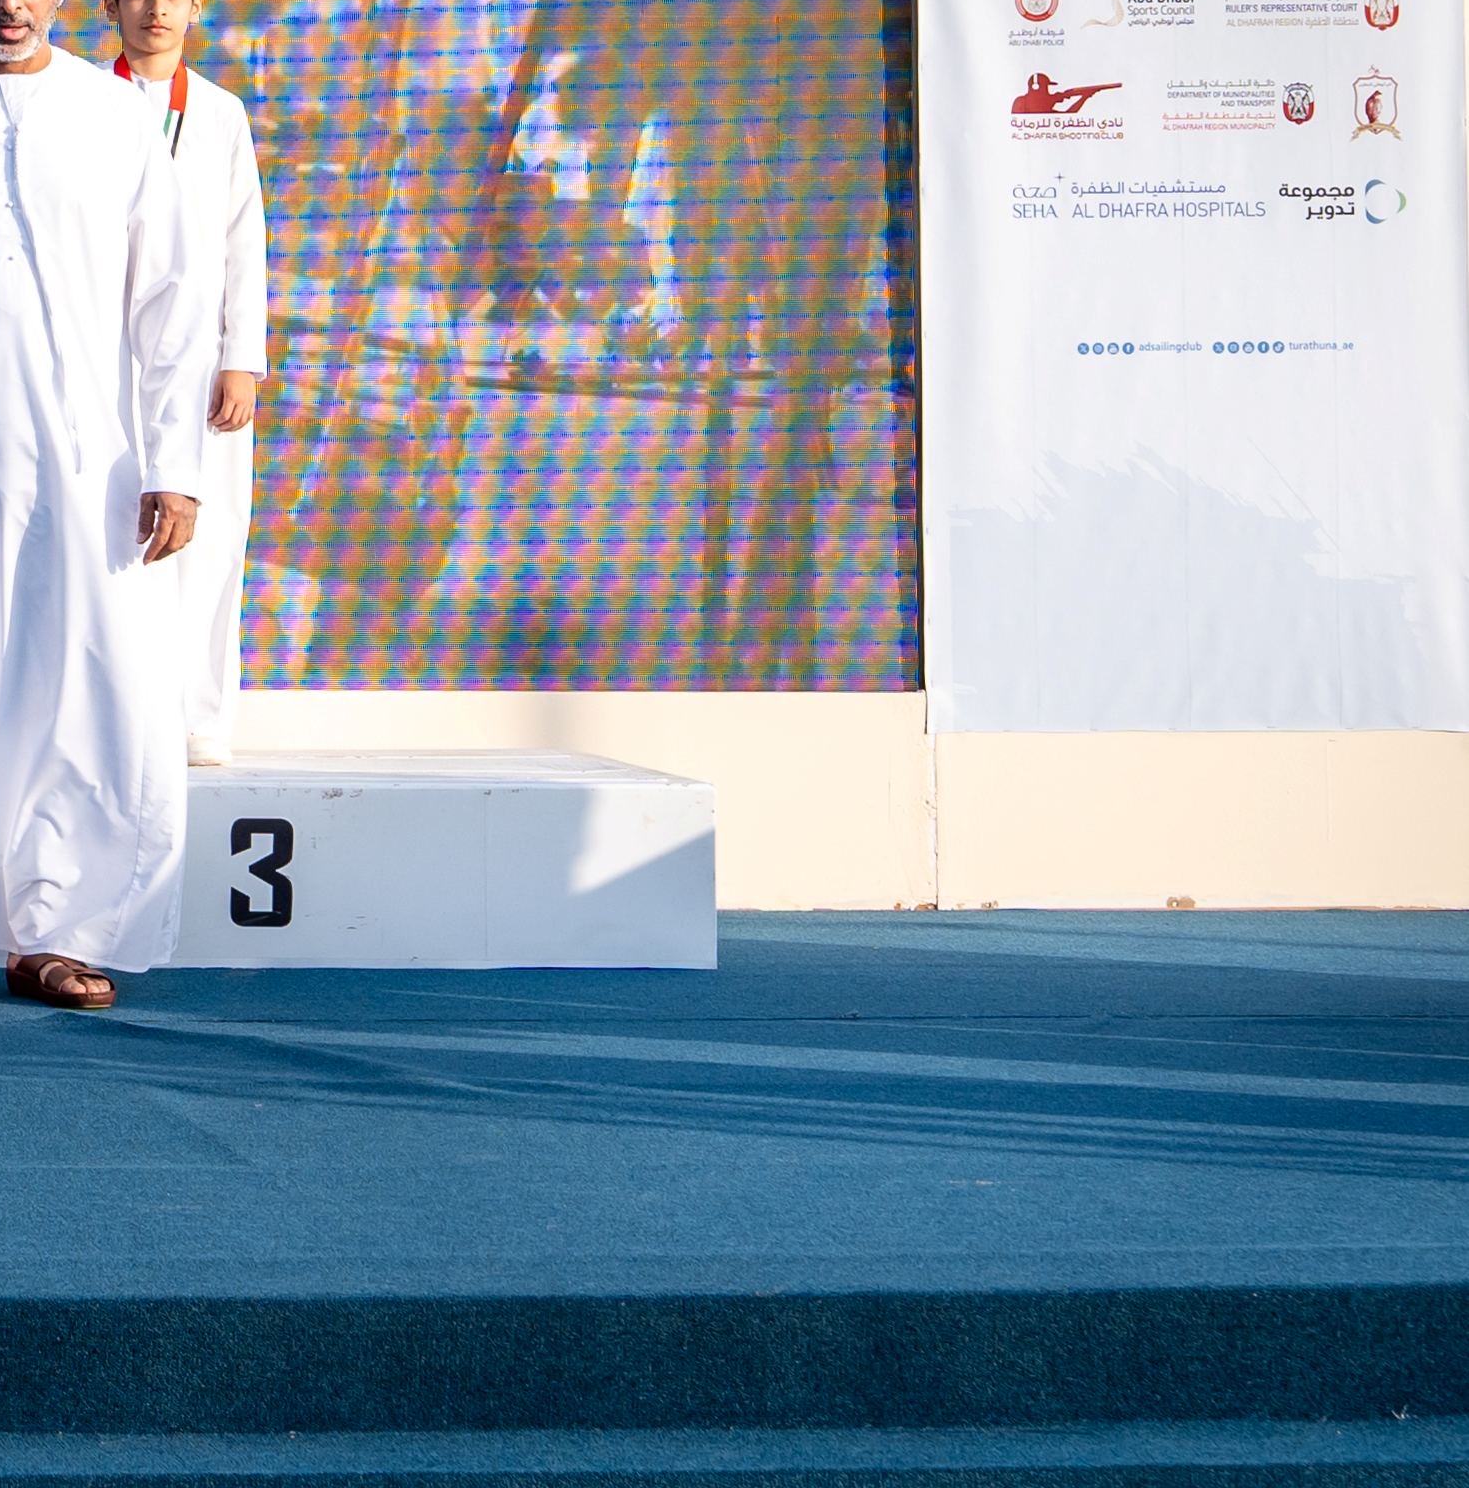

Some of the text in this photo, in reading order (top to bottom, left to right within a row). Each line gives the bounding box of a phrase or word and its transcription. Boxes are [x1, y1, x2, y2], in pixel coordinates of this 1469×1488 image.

[1127, 5, 1195, 17] Sports Council
[1225, 3, 1358, 13] RULER'S REPRESENTATIVE COURT
[1071, 179, 1226, 198] مستشفيات الظفرة
[1278, 184, 1355, 201] مجموعة
[1012, 203, 1059, 218] SEHA
[1072, 201, 1266, 218] AL DHAFRA HOSPITALS
[1305, 202, 1355, 220] تدوير
[1138, 341, 1203, 353] adsailingclub
[1288, 340, 1355, 353] turathuna_ae
[229, 816, 295, 928] 3
